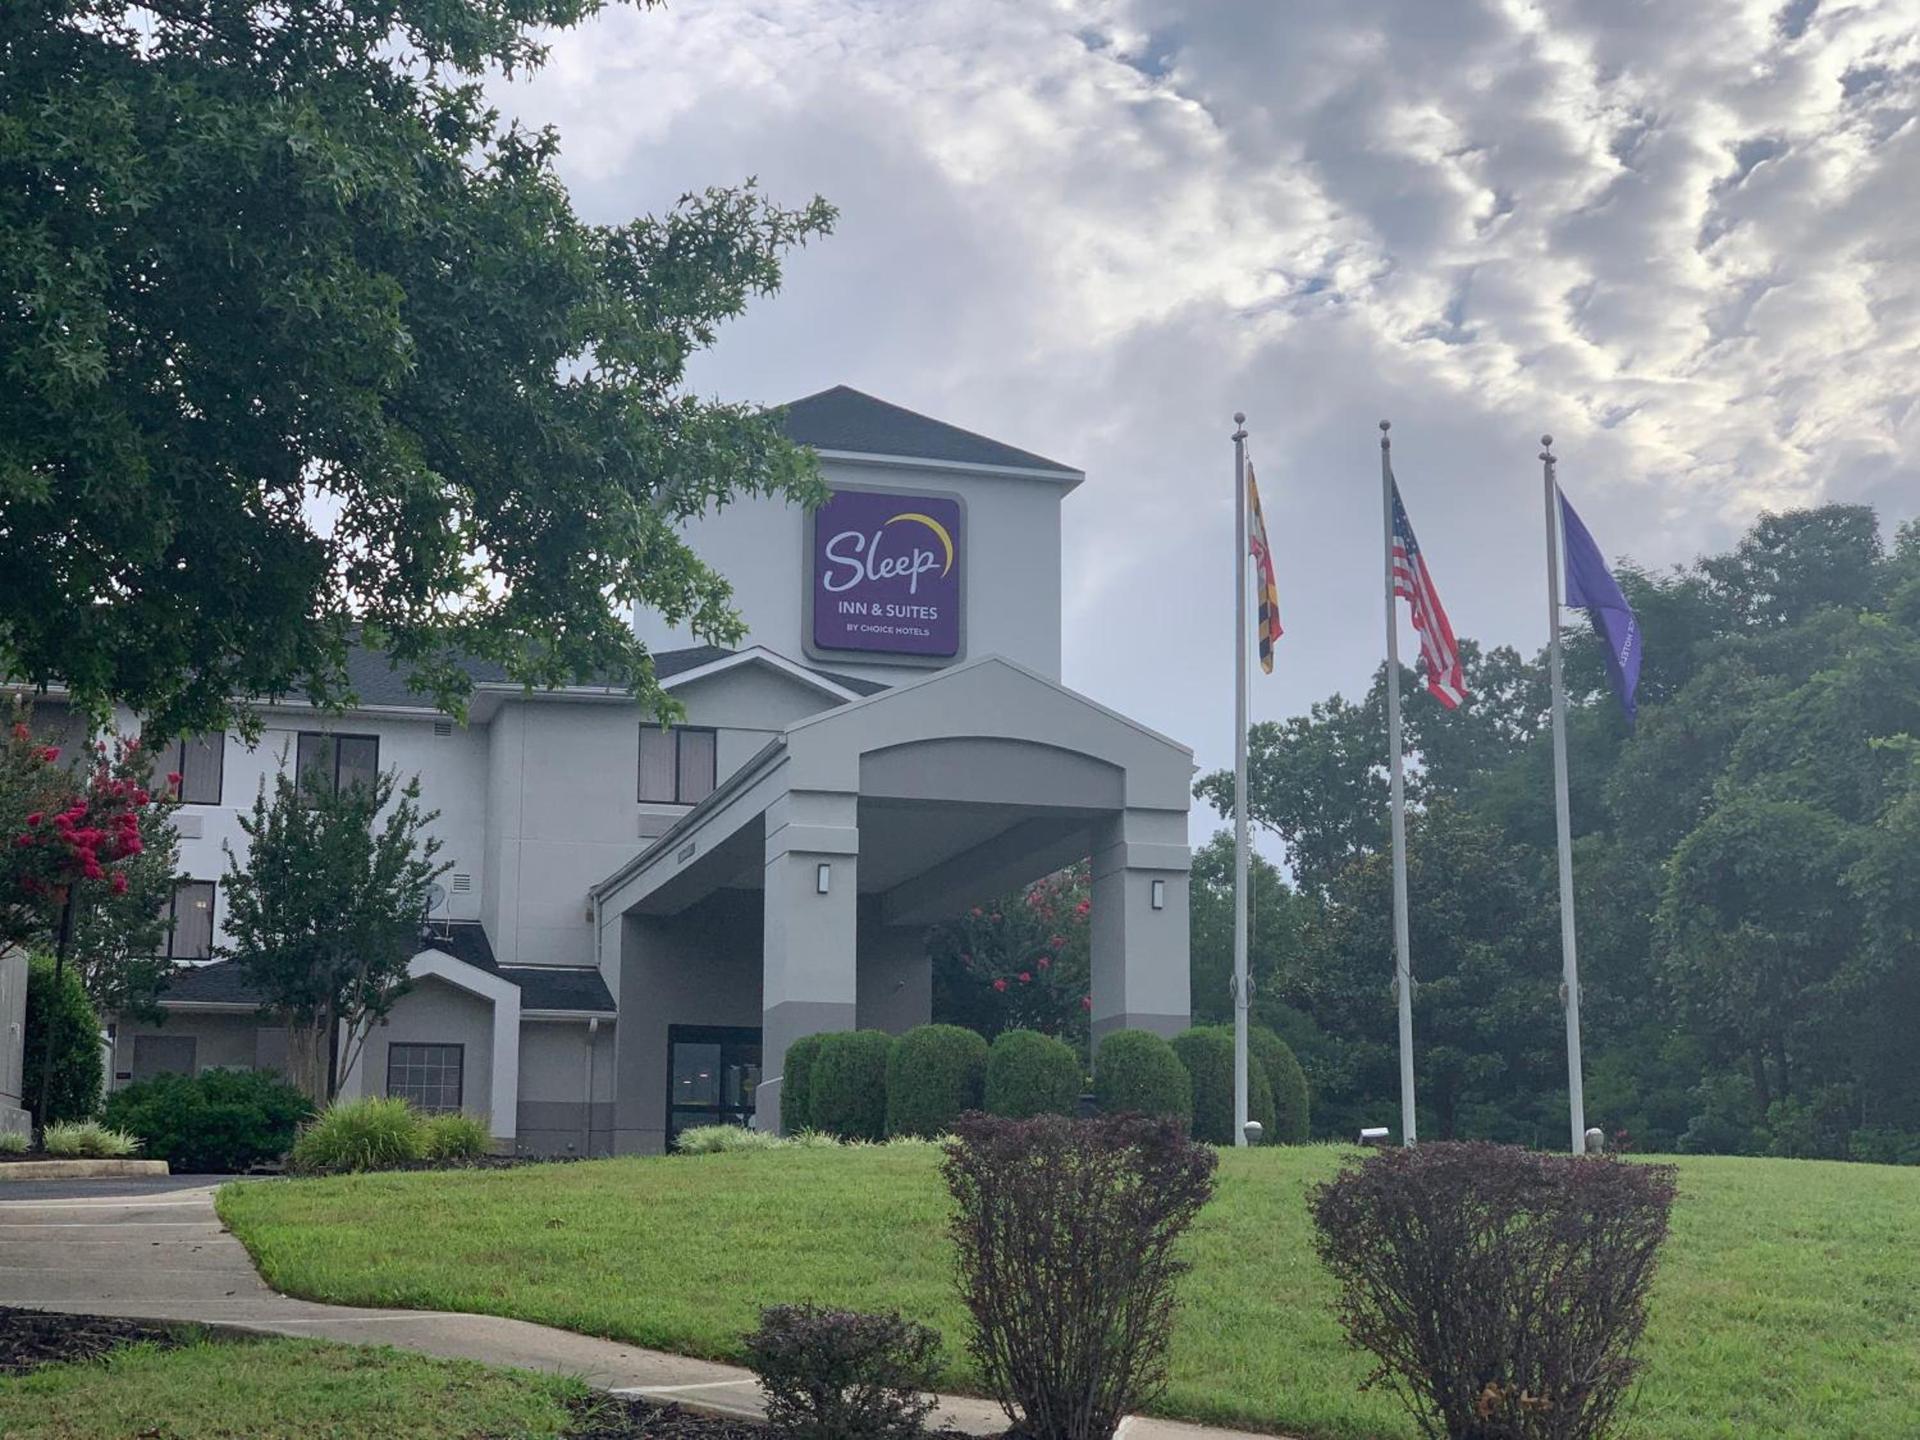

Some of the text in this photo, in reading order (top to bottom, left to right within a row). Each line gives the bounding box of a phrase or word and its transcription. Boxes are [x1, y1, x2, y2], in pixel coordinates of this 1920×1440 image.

[823, 530, 941, 594] Sleep
[838, 601, 938, 620] INN & SUITES
[860, 625, 894, 634] CHOICE
[895, 627, 930, 636] HOTELS
